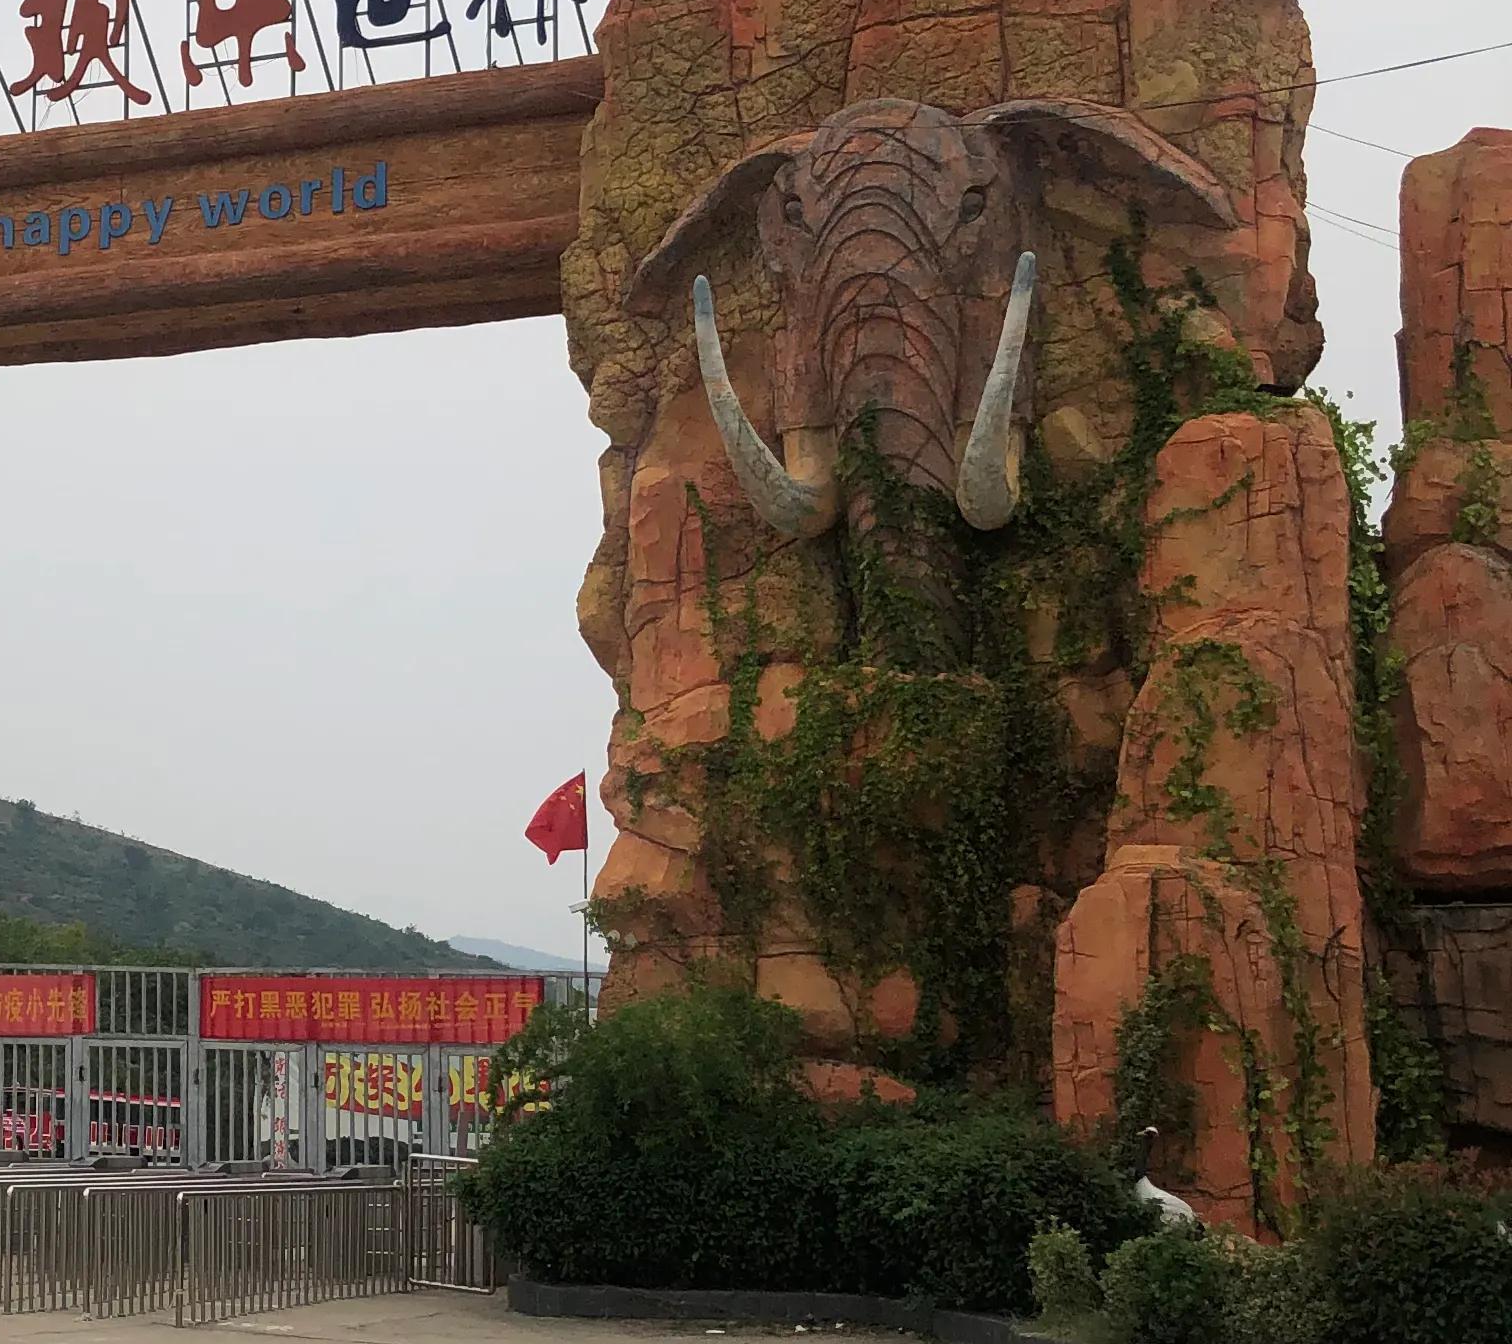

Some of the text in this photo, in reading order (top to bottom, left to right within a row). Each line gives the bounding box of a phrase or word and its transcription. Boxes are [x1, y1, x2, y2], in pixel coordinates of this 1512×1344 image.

[199, 162, 387, 227] world
[210, 989, 535, 1020] 严打黑恶犯罪 弘扬社会正气
